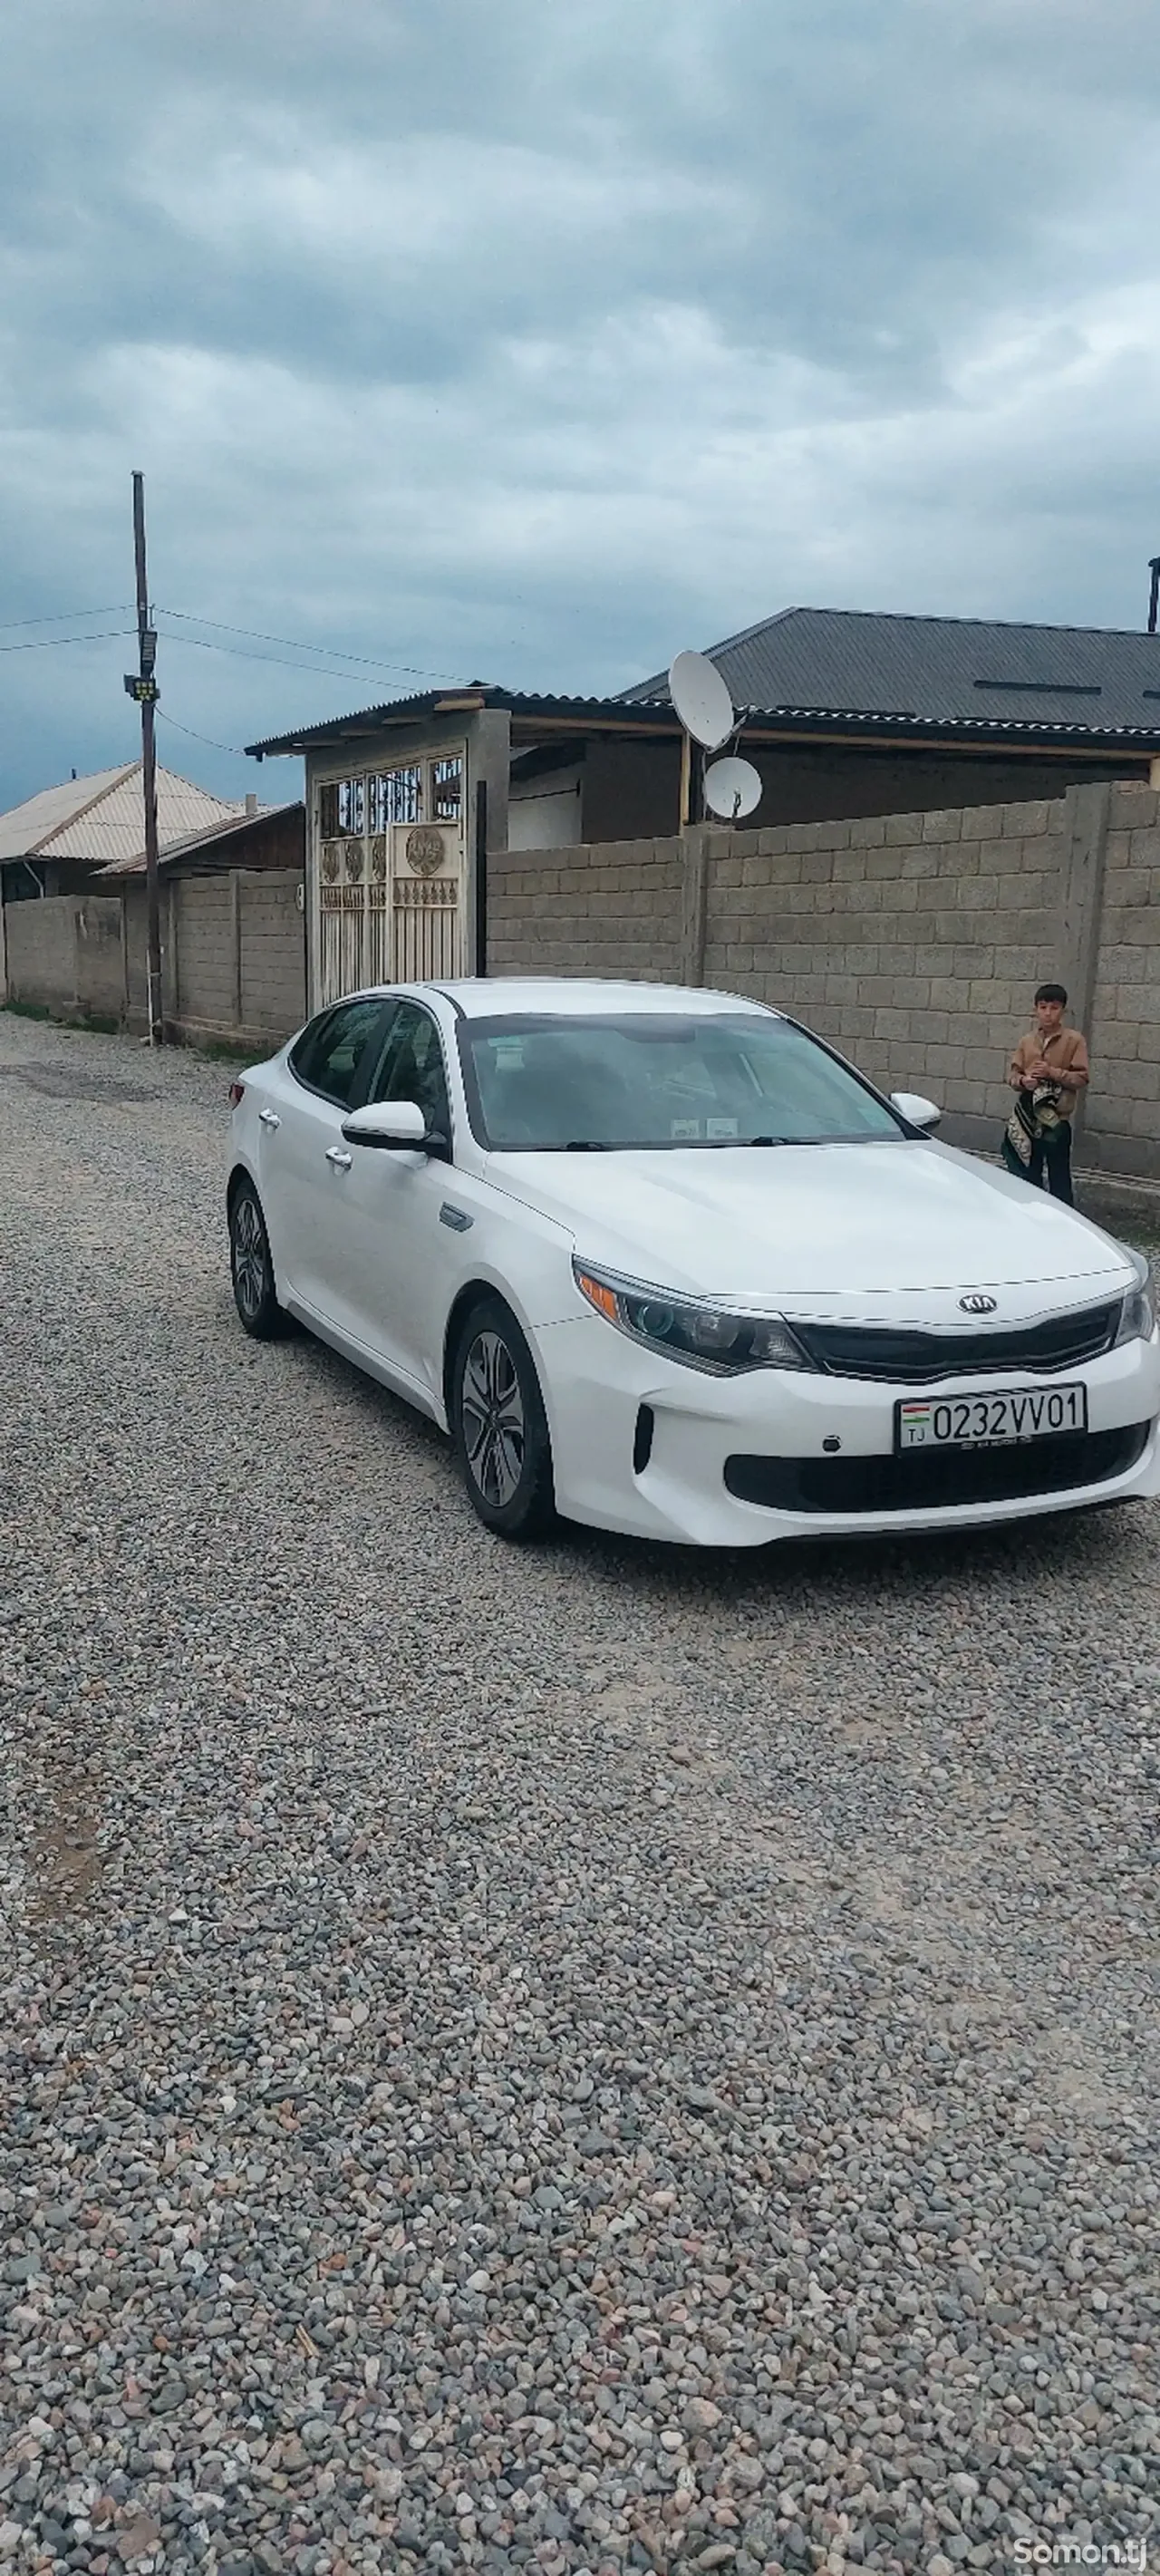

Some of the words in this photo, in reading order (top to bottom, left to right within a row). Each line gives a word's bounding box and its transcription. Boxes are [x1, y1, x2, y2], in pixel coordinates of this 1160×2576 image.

[961, 1295, 995, 1311] KIA
[933, 1392, 1076, 1439] 0232VV01
[908, 1428, 925, 1443] TJ
